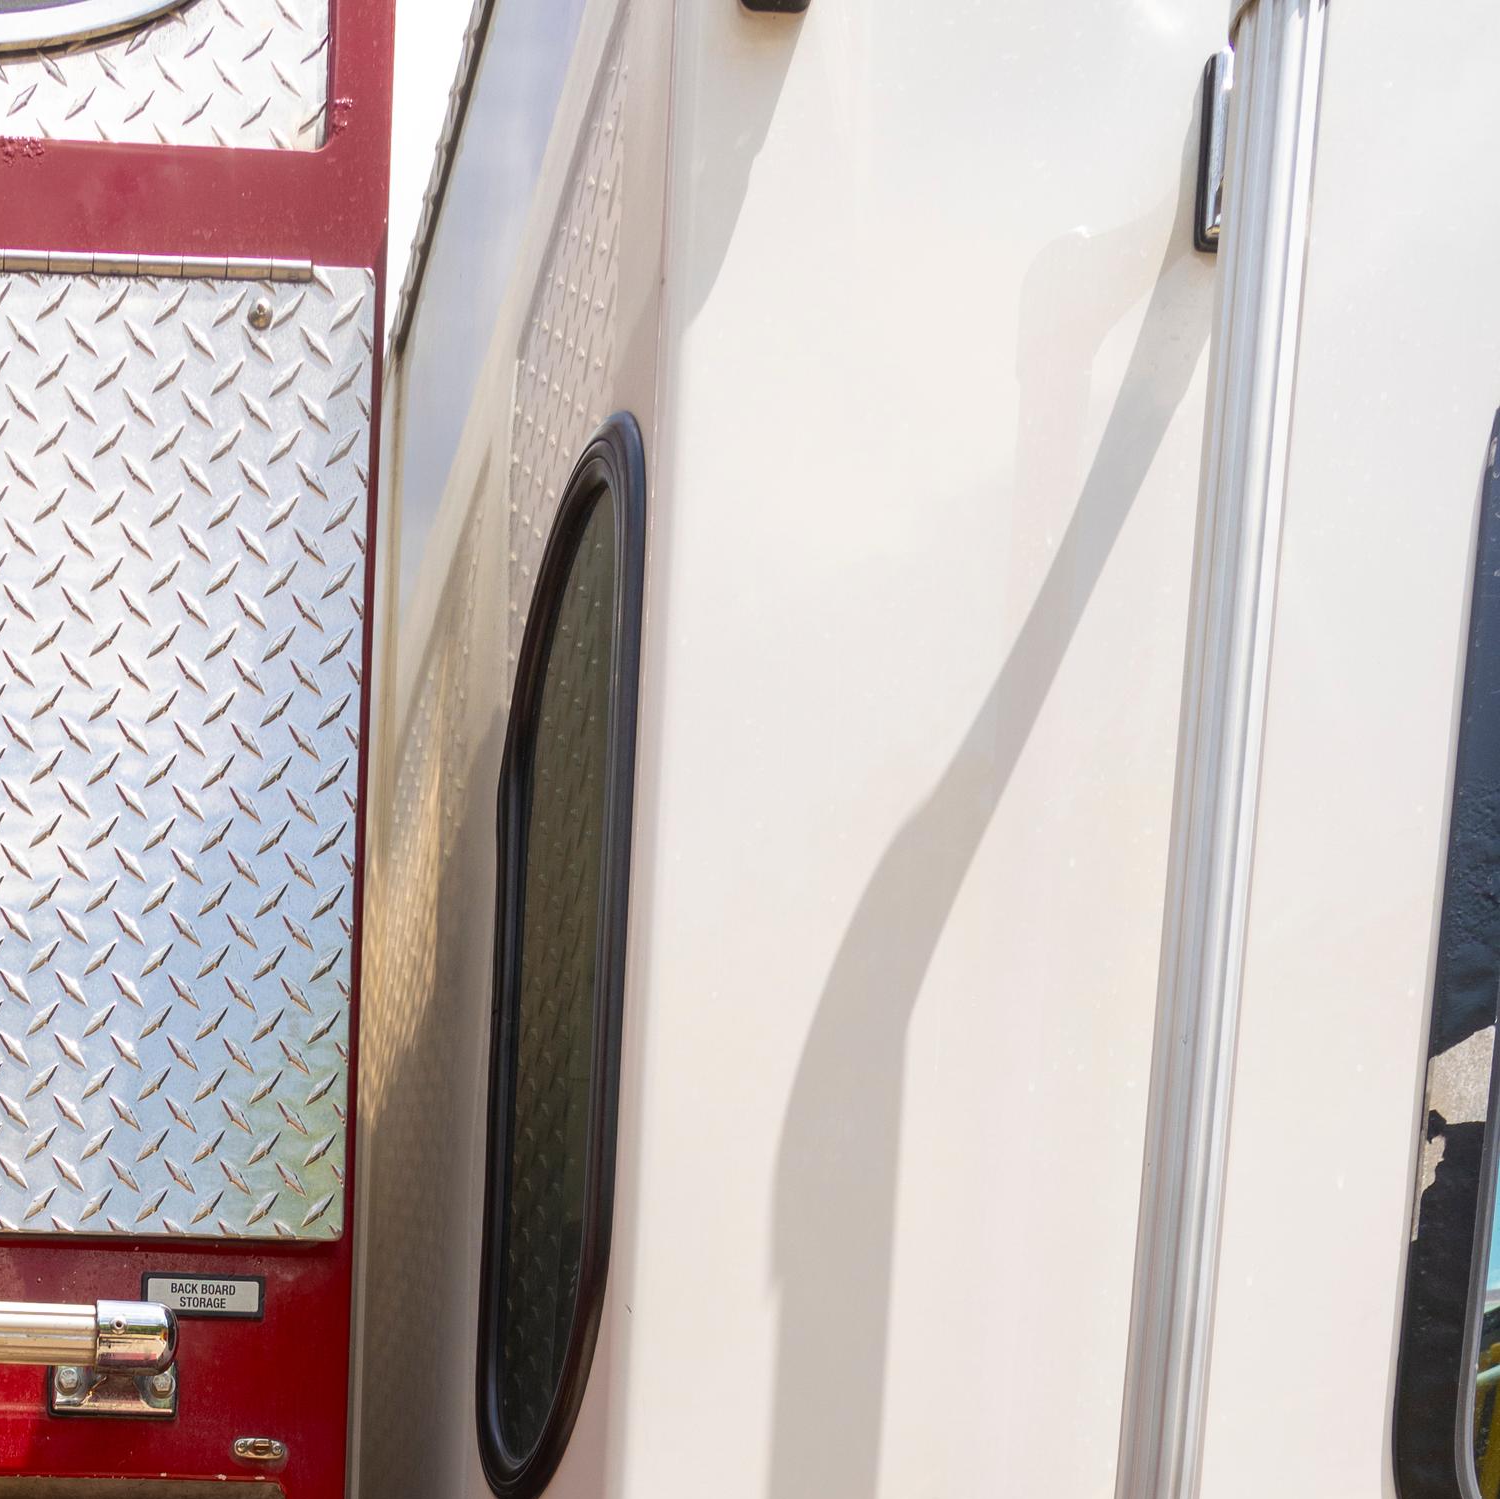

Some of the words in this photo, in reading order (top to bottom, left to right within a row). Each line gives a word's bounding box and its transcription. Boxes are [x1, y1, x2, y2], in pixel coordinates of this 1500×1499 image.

[171, 1283, 198, 1294] BACK
[201, 1284, 235, 1296] BOARD
[180, 1296, 226, 1309] STORAGE
